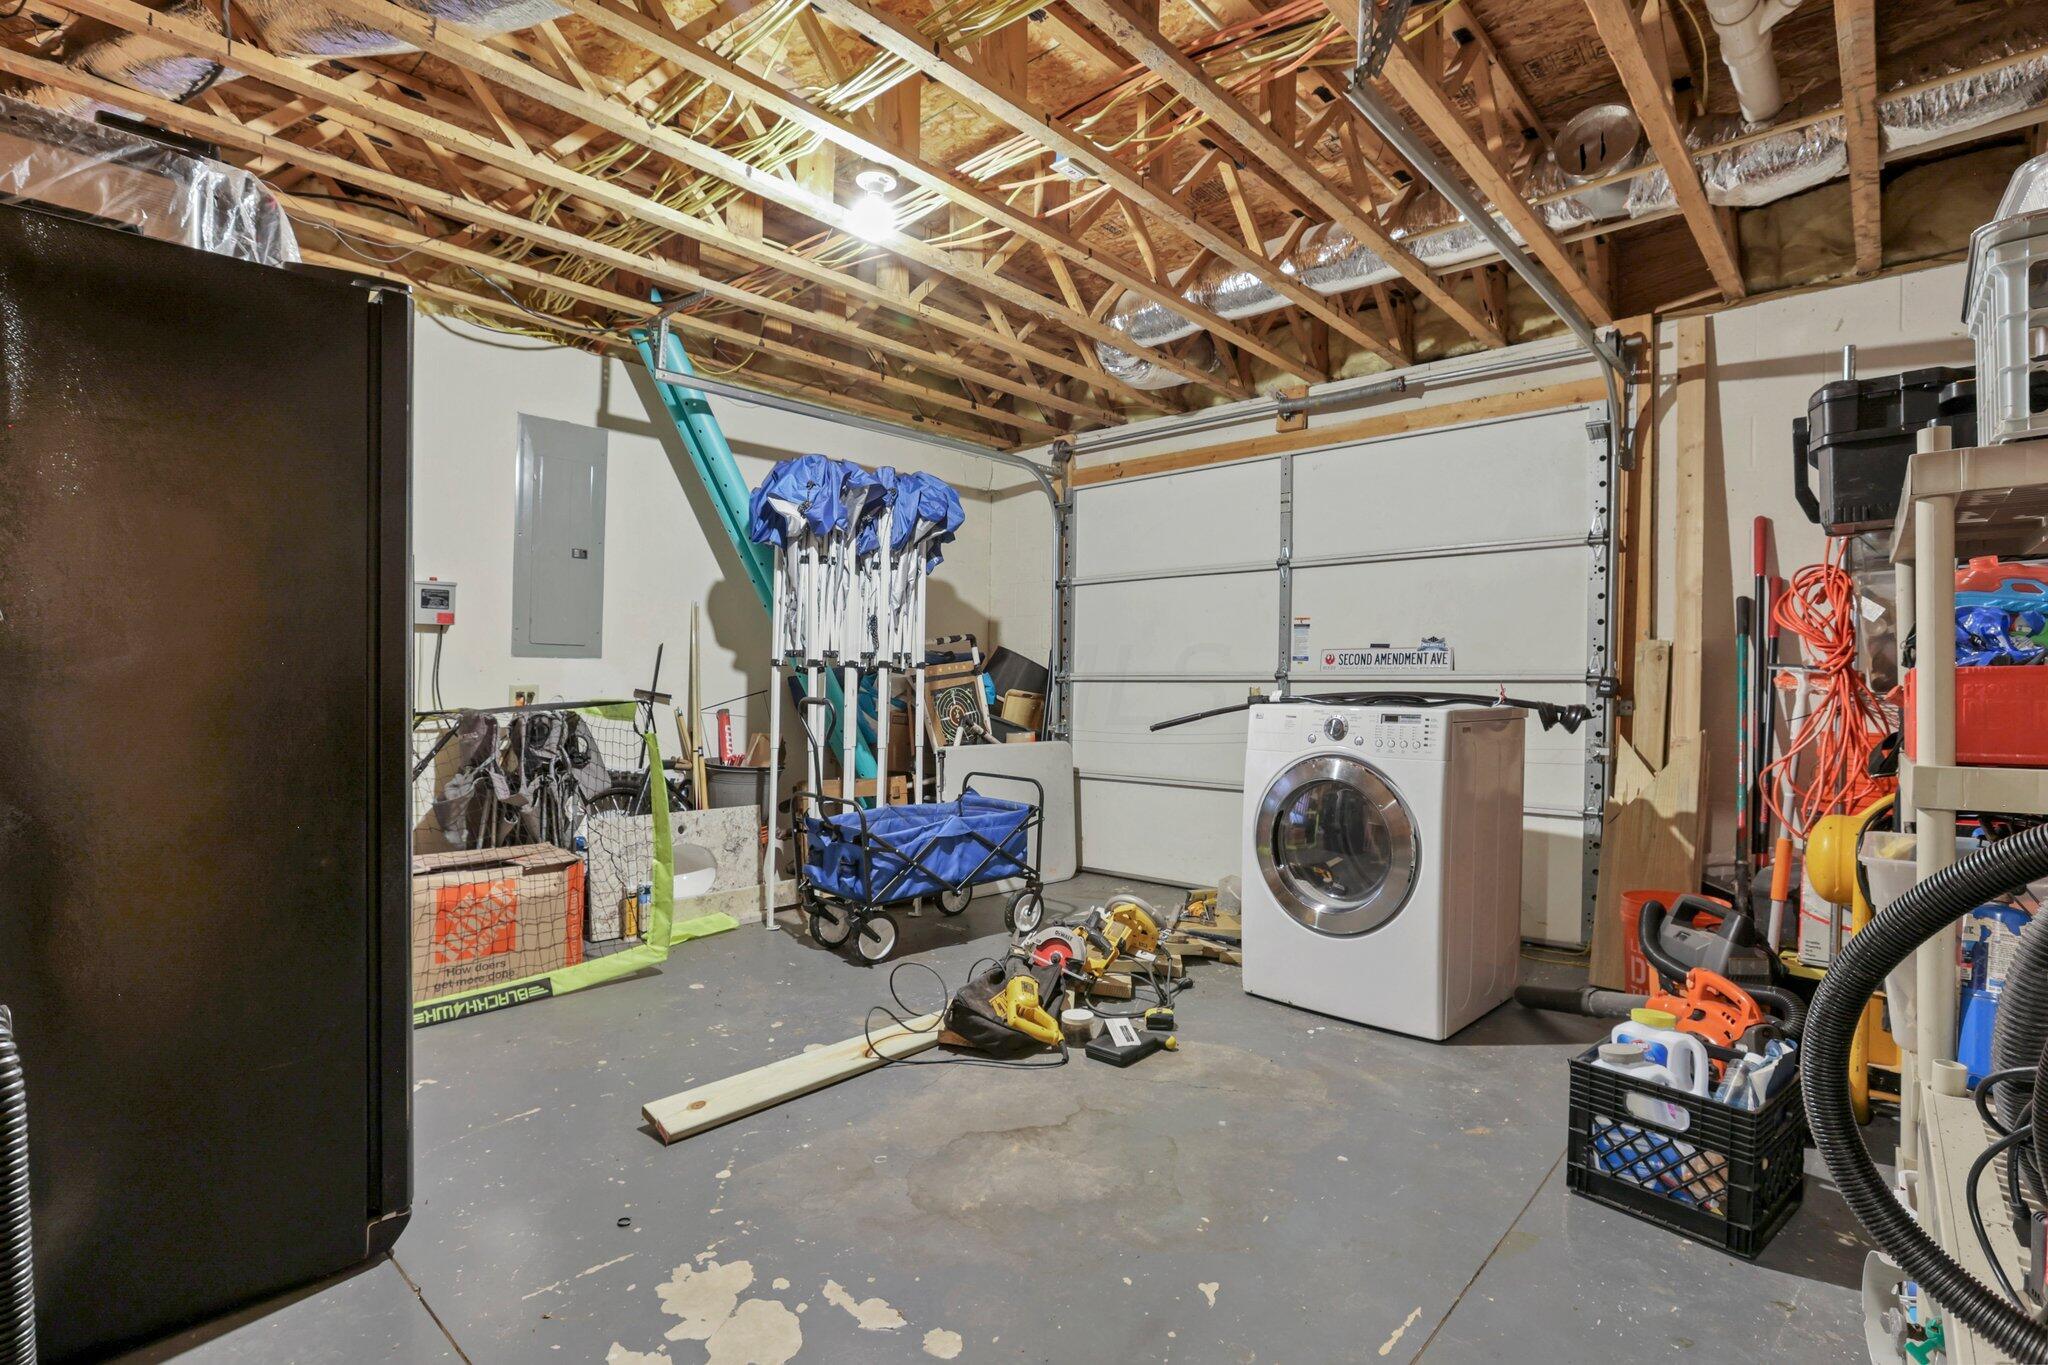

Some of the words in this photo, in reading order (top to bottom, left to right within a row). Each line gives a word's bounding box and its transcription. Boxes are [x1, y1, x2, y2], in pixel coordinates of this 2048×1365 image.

[1338, 653, 1372, 666] SECOND
[1374, 652, 1430, 665] AMENDMENT
[1430, 652, 1448, 665] AVE
[446, 966, 472, 977] How
[475, 960, 506, 972] doers
[434, 980, 453, 992] get
[456, 975, 485, 985] more
[426, 986, 530, 1023] BLACKHAWK
